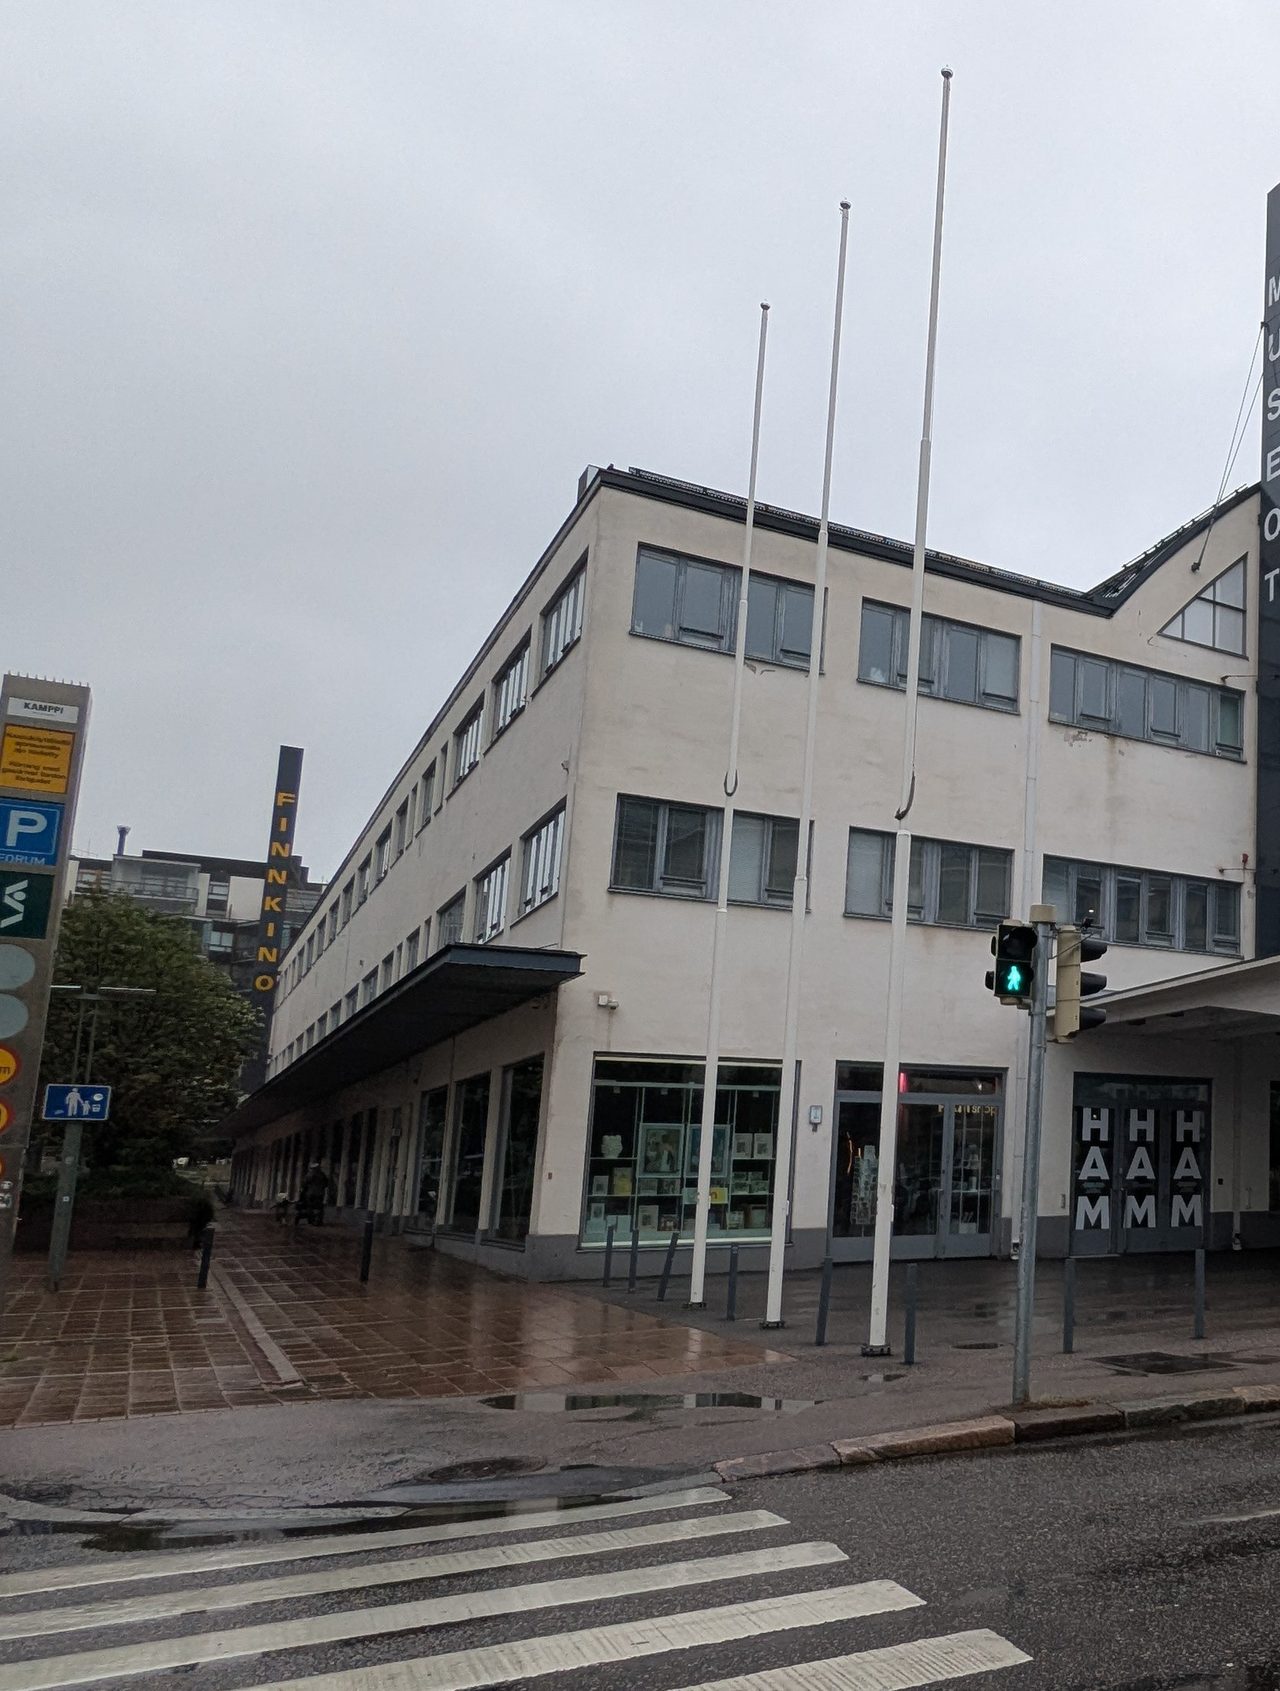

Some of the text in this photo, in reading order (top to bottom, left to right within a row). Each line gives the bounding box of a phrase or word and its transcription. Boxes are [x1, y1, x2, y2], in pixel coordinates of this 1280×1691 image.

[24, 702, 64, 714] KAMPPI
[6, 810, 47, 847] P
[255, 792, 296, 990] FINNKINO
[1075, 1107, 1110, 1230] HAM
[1123, 1108, 1156, 1228] HAM
[1171, 1110, 1203, 1227] HAM
